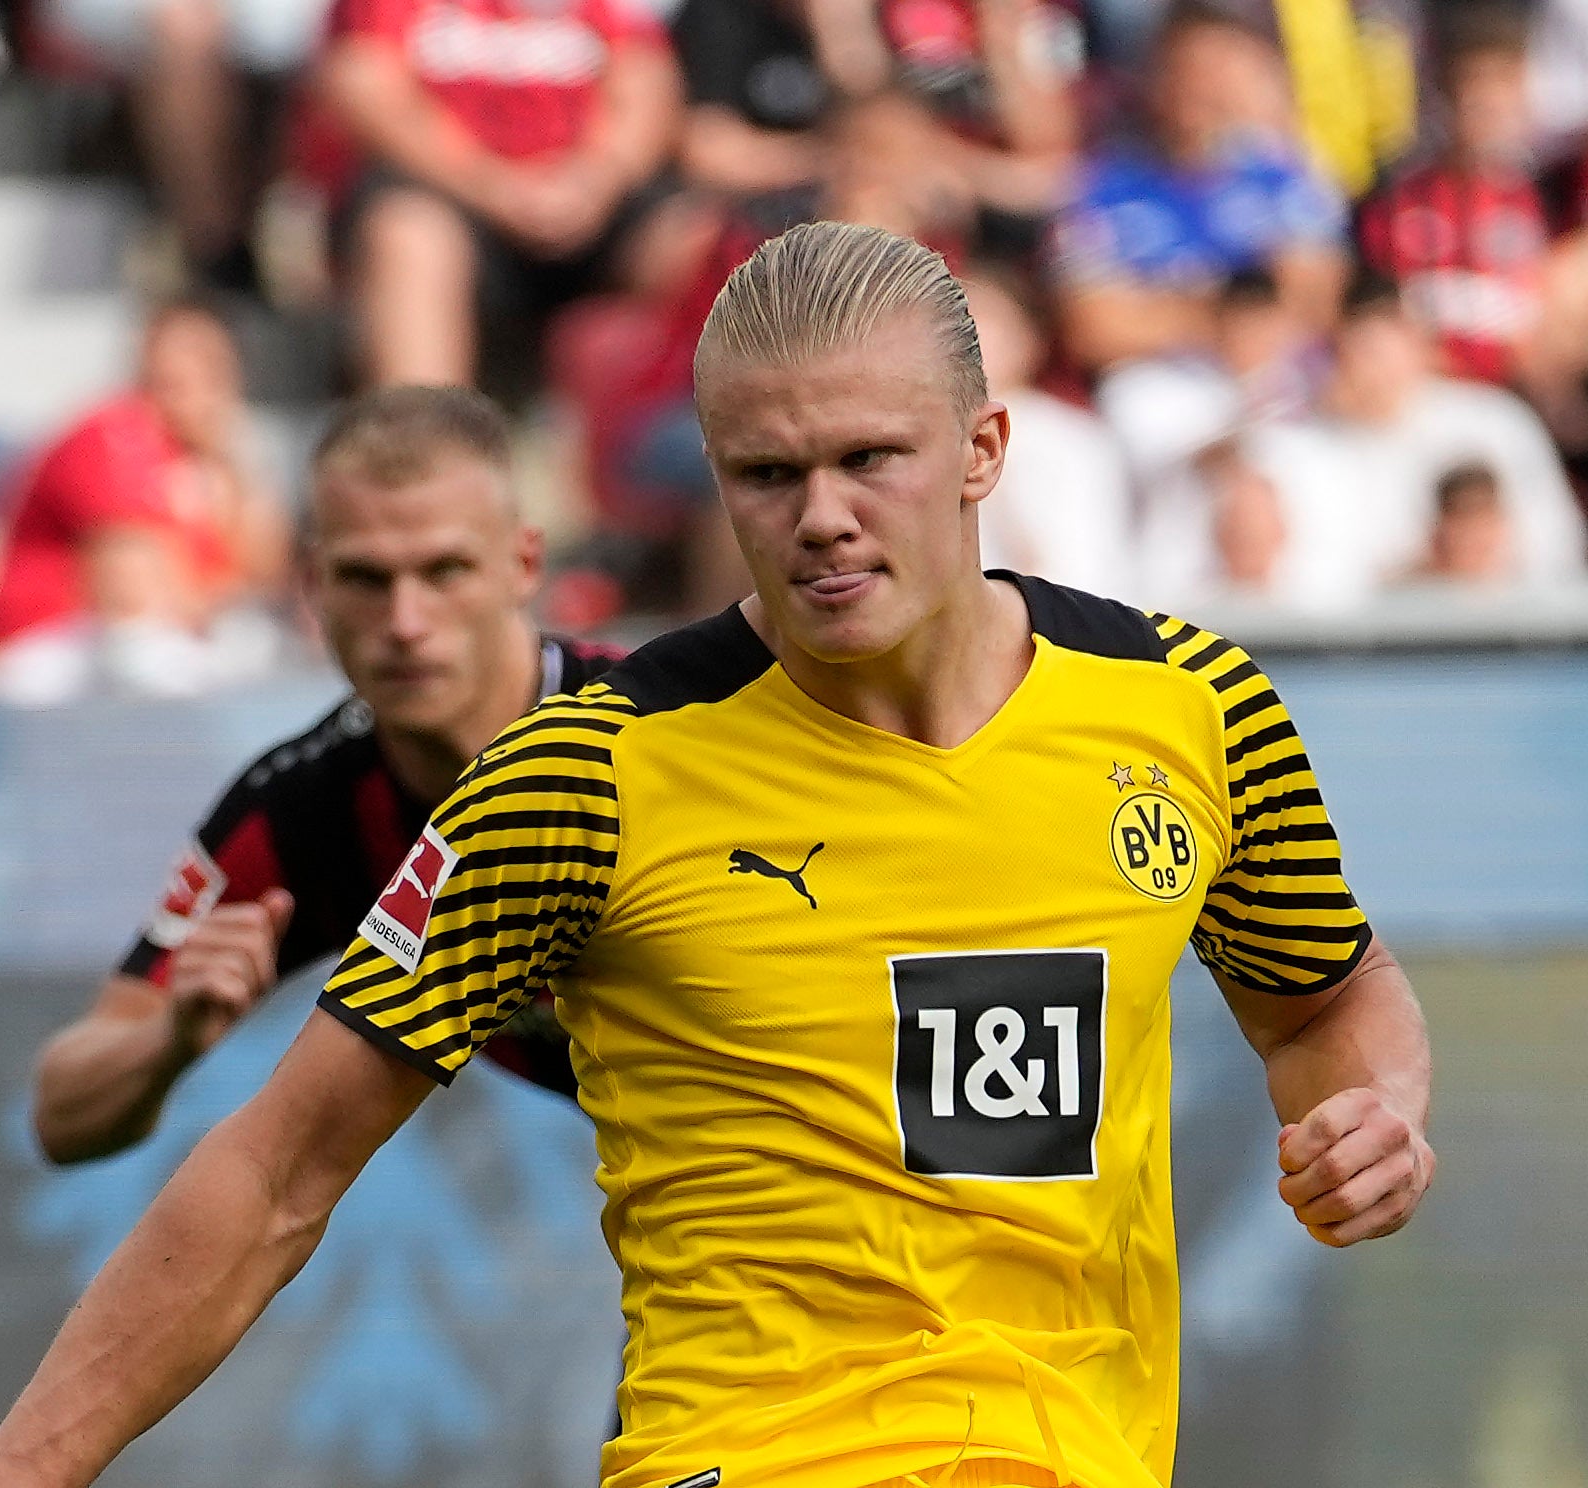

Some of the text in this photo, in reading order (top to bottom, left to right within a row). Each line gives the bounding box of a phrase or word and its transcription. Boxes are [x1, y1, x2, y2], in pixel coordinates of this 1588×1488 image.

[1121, 803, 1190, 869] BVB
[1152, 867, 1176, 889] 09
[365, 911, 416, 960] UNDESLIGA
[918, 1006, 1080, 1118] 1&1
